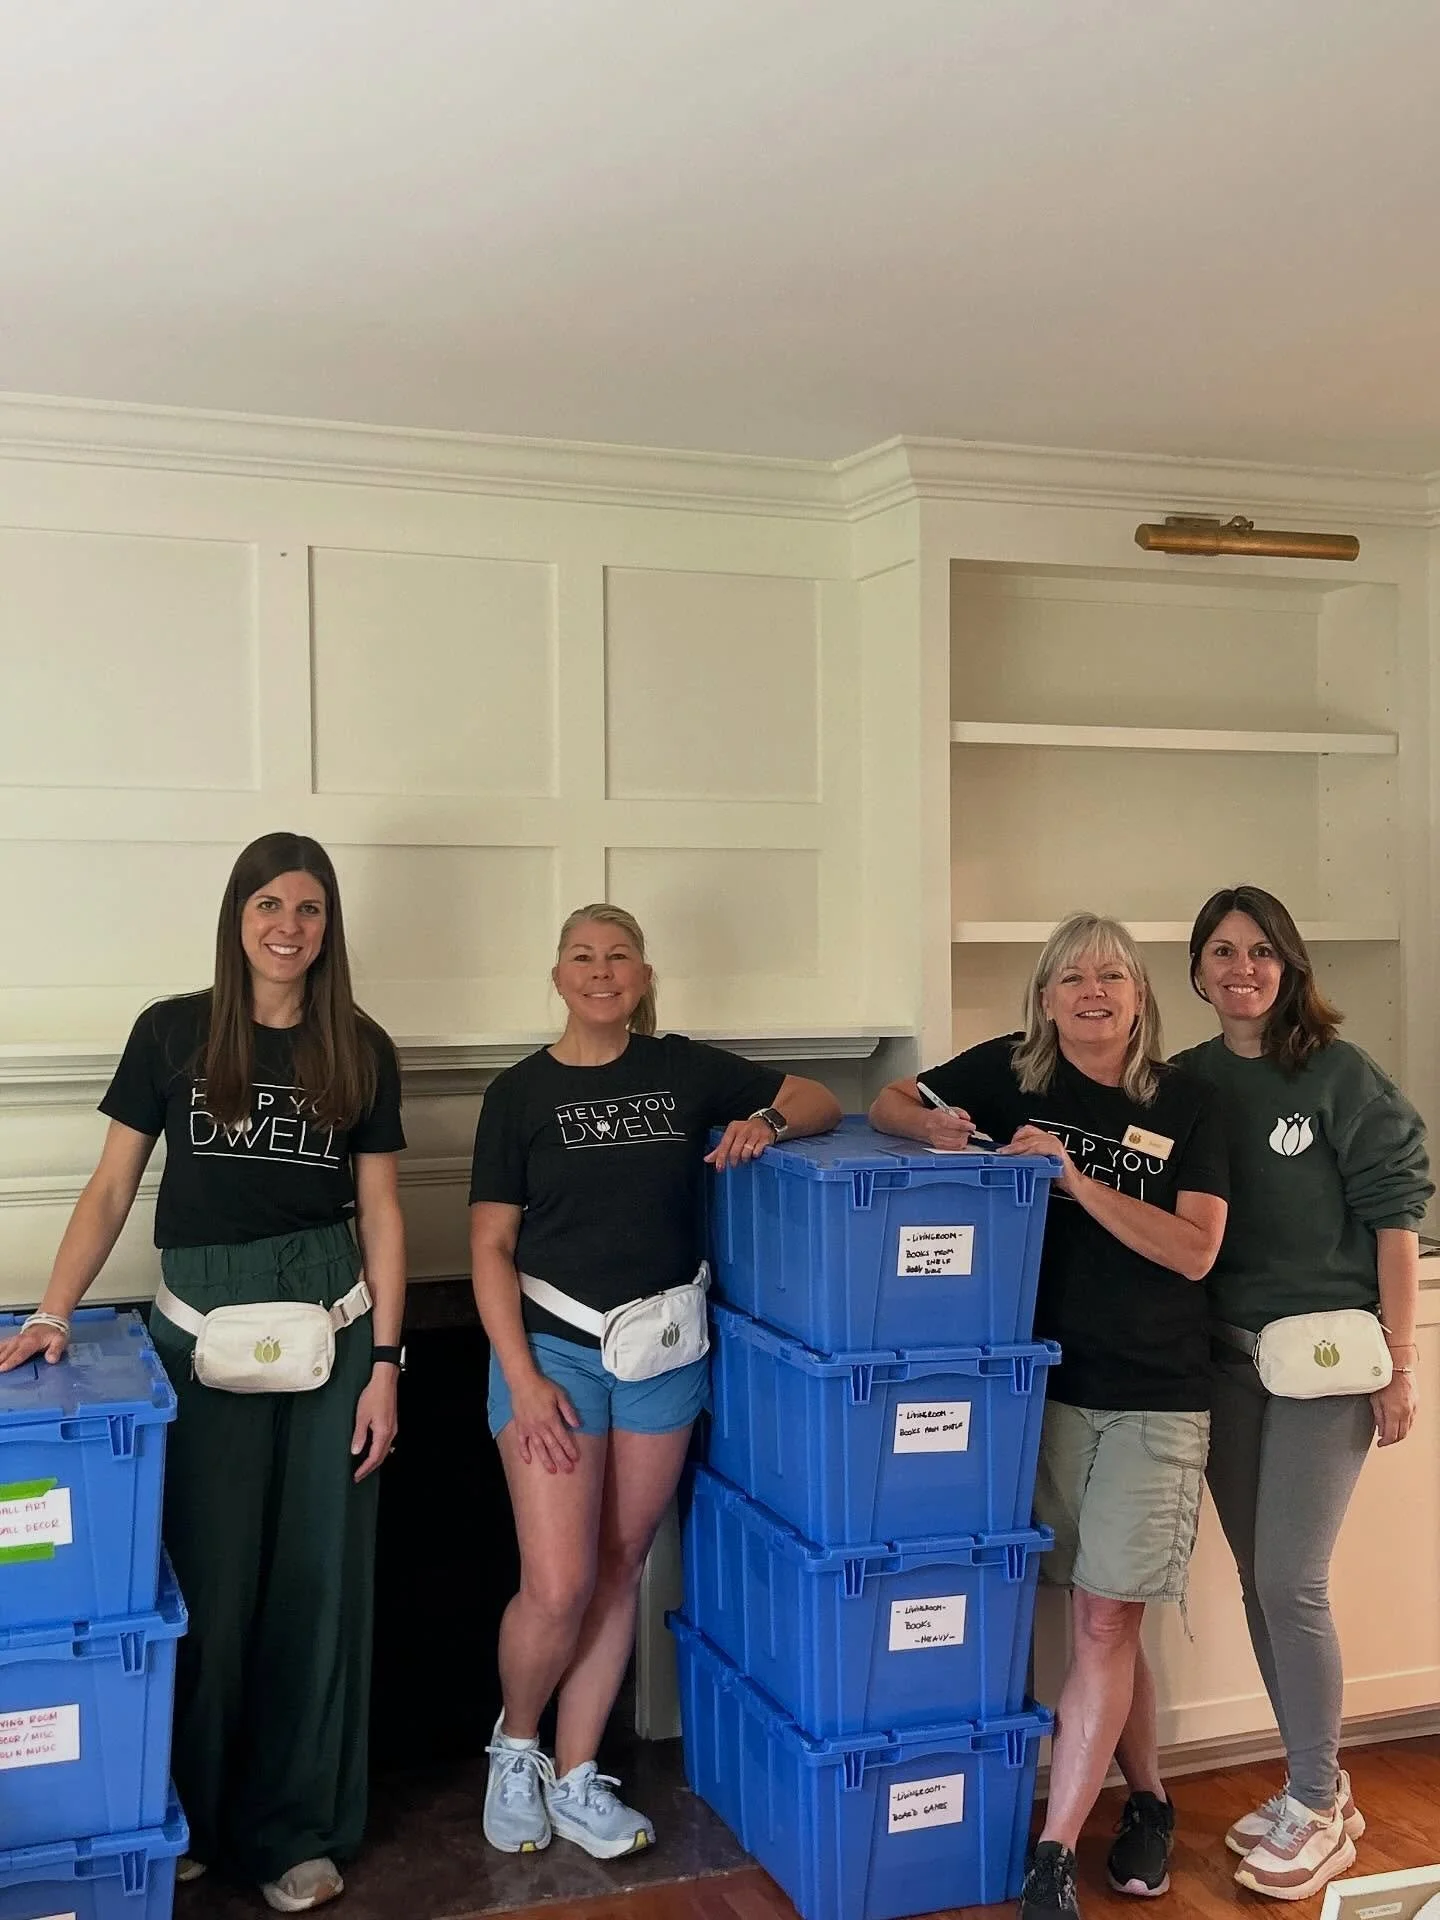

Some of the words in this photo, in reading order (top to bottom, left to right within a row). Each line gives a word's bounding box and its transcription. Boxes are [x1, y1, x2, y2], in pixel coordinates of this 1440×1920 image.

[191, 1087, 275, 1110] HP
[557, 1104, 619, 1125] HELP
[628, 1097, 676, 1113] YOU
[190, 1111, 340, 1160] DWELL
[561, 1113, 685, 1144] DWELL
[1107, 1148, 1164, 1174] YOU
[905, 1250, 930, 1259] BOOKS
[899, 1427, 920, 1436] BOOKS
[0, 1505, 19, 1515] ALL
[25, 1501, 47, 1512] ART
[25, 1519, 59, 1533] DECOR
[904, 1620, 932, 1630] BOOKS
[30, 1712, 57, 1723] ROOM
[892, 1808, 918, 1821] BOARD
[924, 1802, 948, 1814] GAMES
